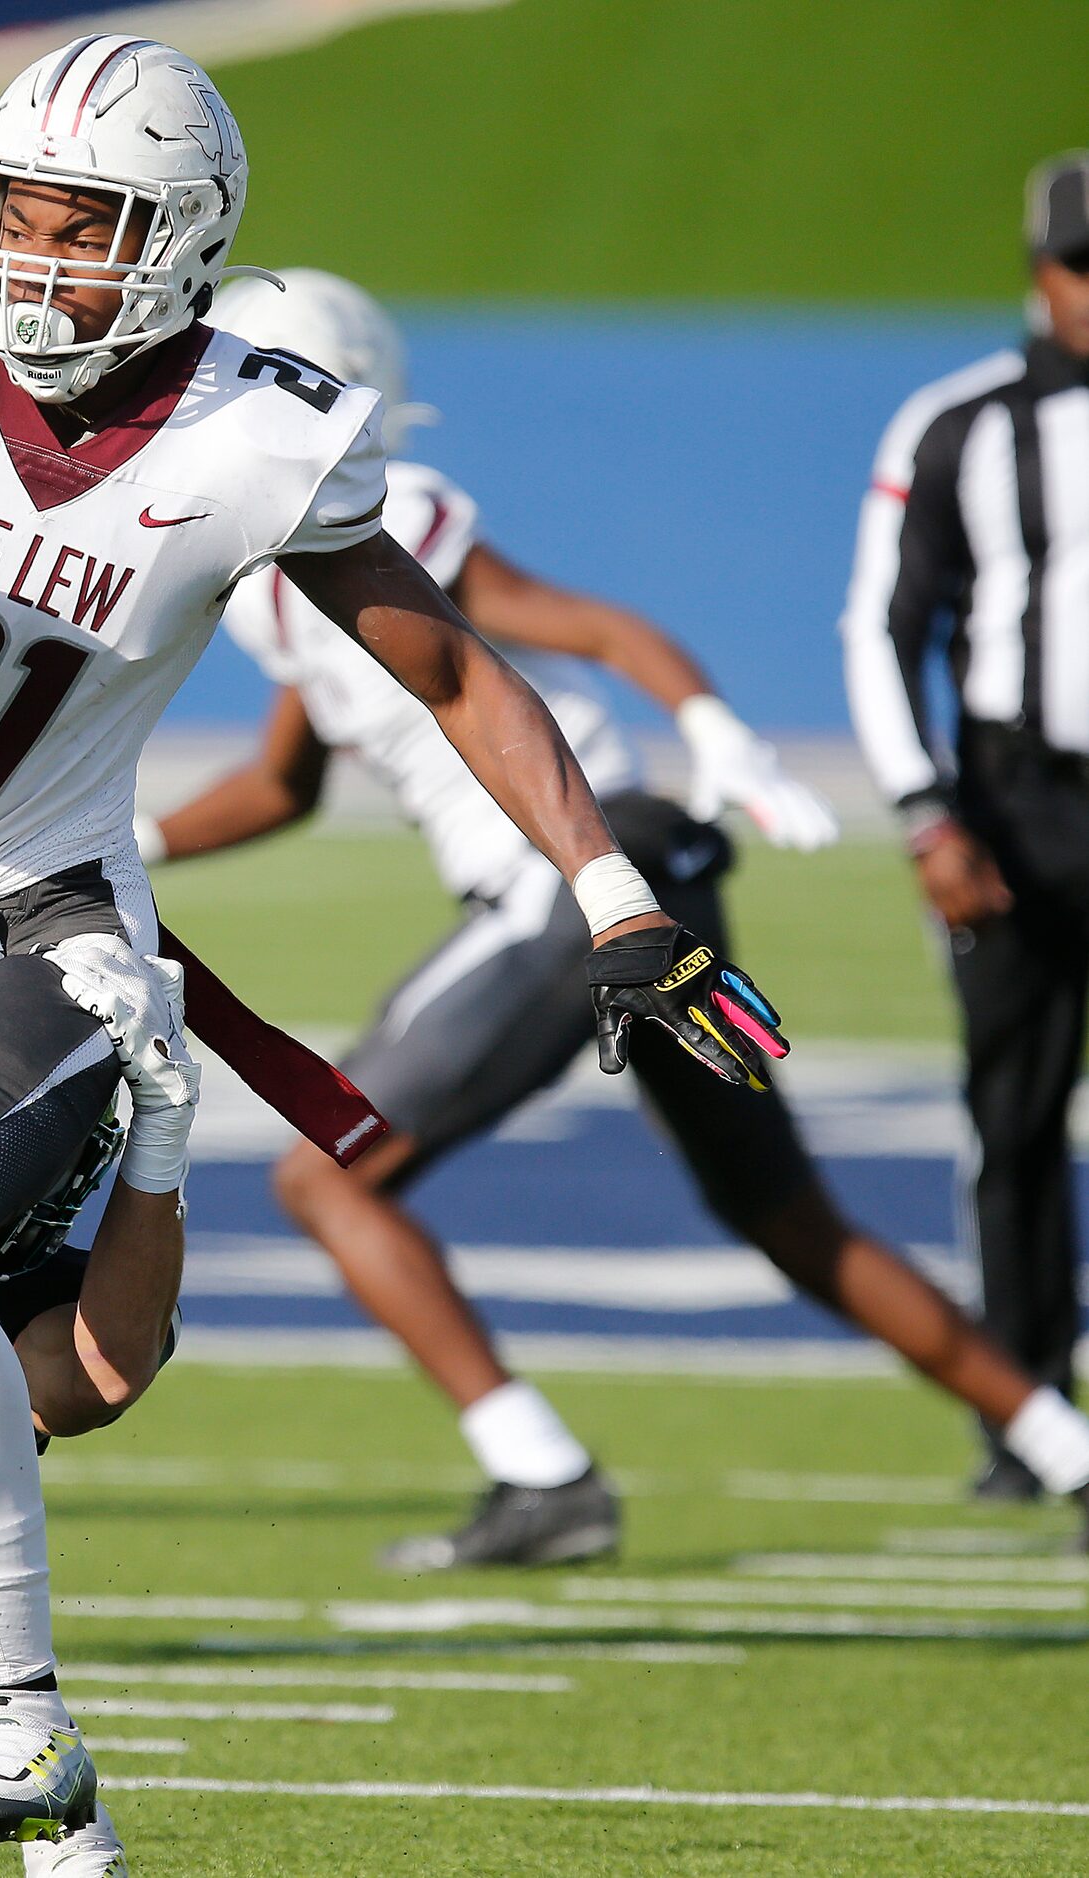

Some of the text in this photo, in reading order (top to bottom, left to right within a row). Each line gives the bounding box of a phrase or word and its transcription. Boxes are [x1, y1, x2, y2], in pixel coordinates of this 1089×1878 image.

[236, 346, 347, 414] 21
[7, 534, 136, 633] LEW
[662, 950, 710, 987] BATTLE
